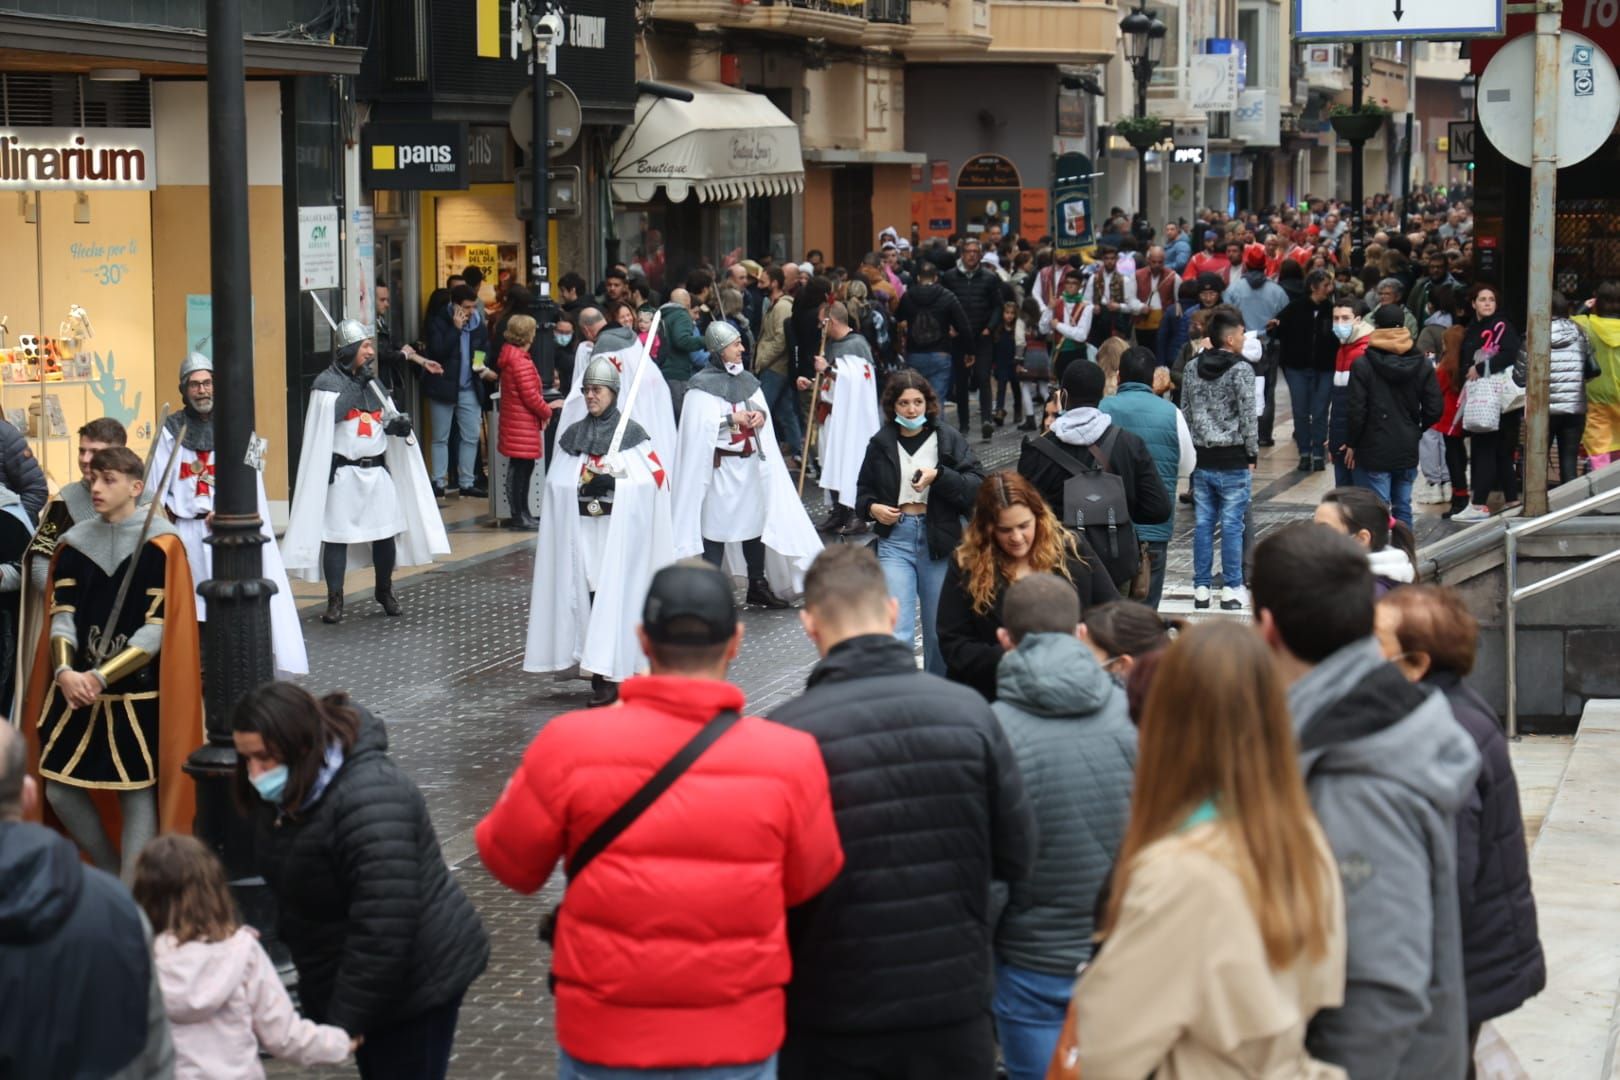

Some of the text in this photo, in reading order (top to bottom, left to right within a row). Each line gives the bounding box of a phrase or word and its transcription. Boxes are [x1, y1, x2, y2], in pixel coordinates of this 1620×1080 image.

[1193, 102, 1232, 110] AUDITIVO
[0, 136, 145, 181] linarium
[398, 144, 451, 169] pans
[468, 135, 492, 165] ans
[637, 159, 689, 178] Boutique
